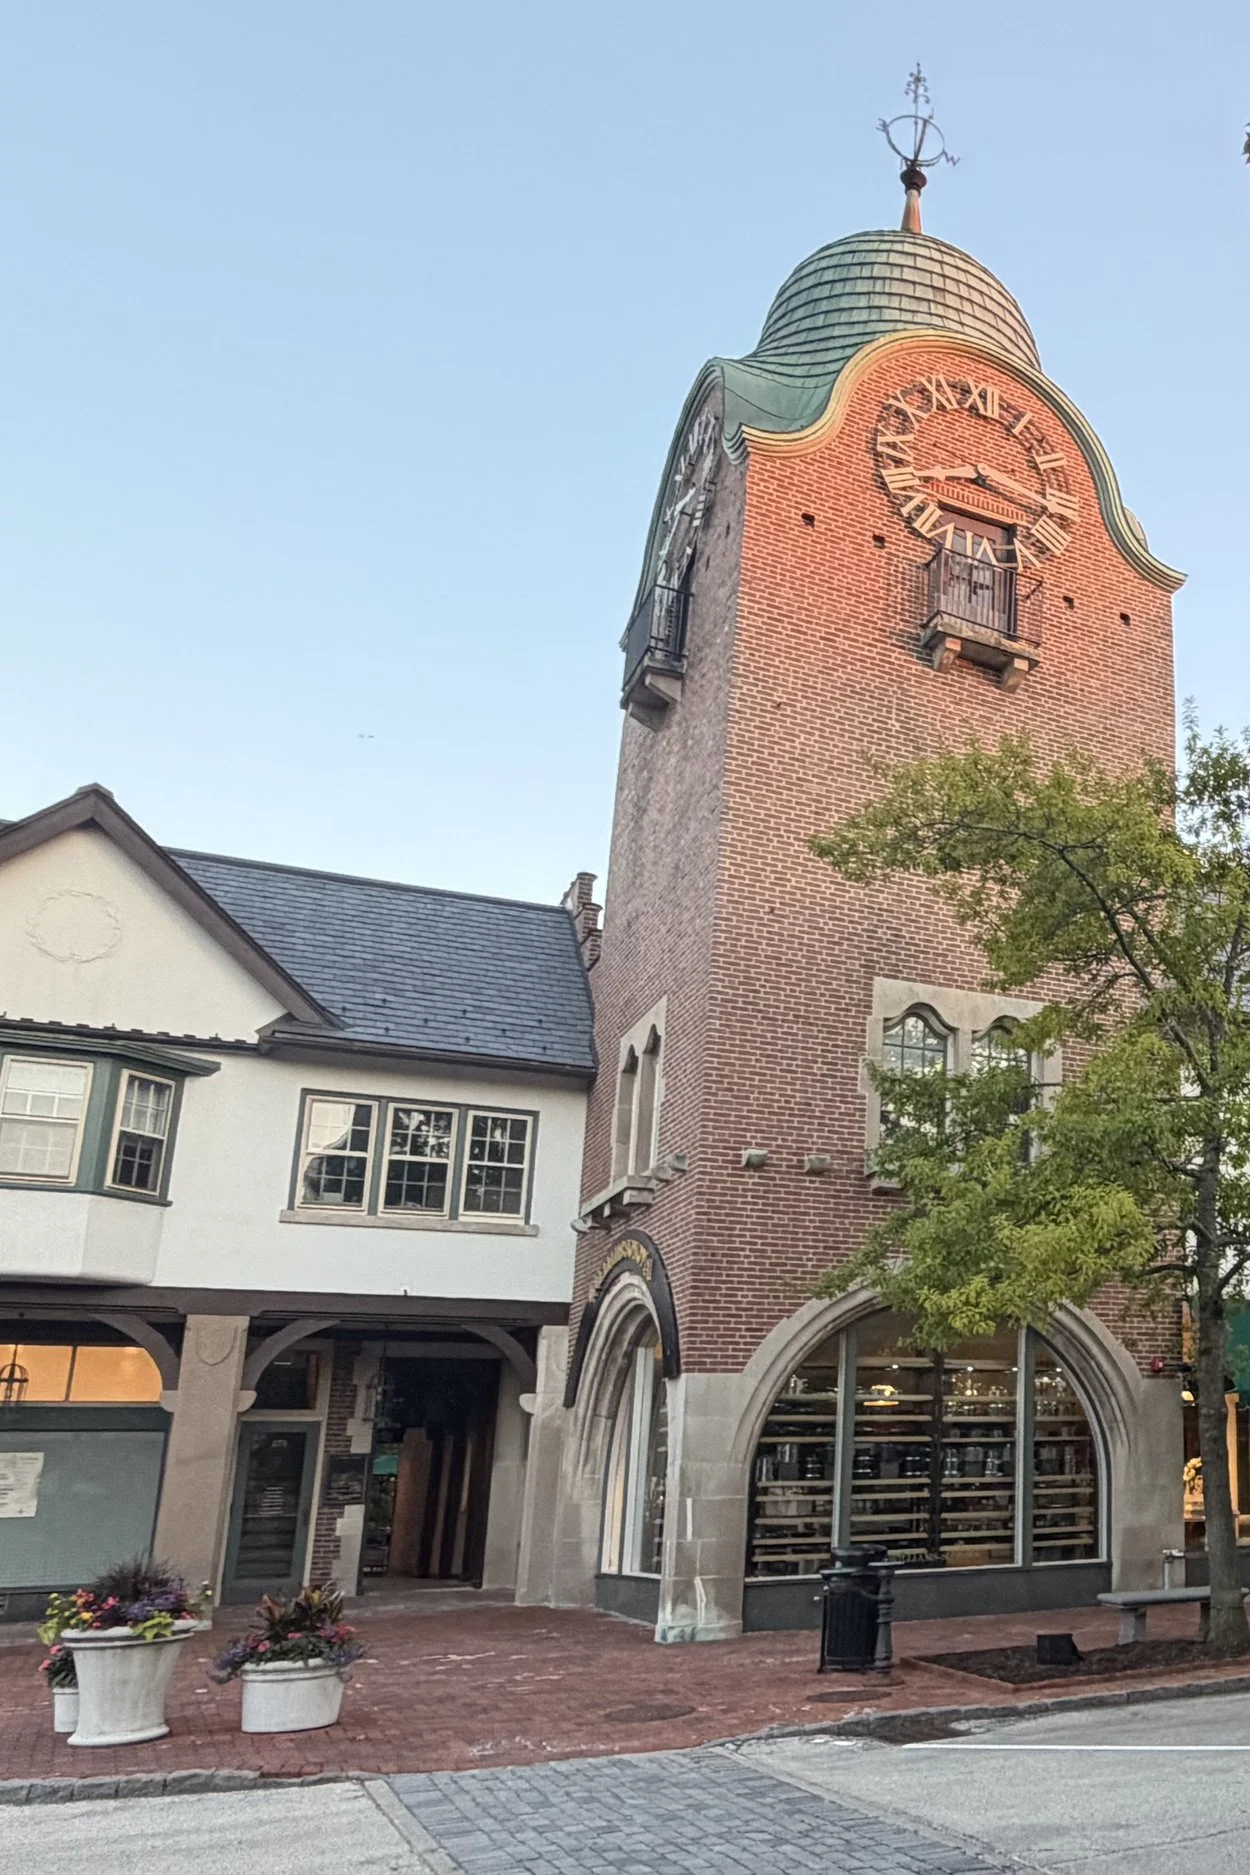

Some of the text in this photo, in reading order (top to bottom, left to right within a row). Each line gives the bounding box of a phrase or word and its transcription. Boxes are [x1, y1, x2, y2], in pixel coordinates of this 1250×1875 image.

[887, 391, 930, 430] X
[920, 374, 960, 412] XI
[964, 376, 1001, 419] XII
[877, 424, 915, 463] IX
[1031, 448, 1068, 472] II
